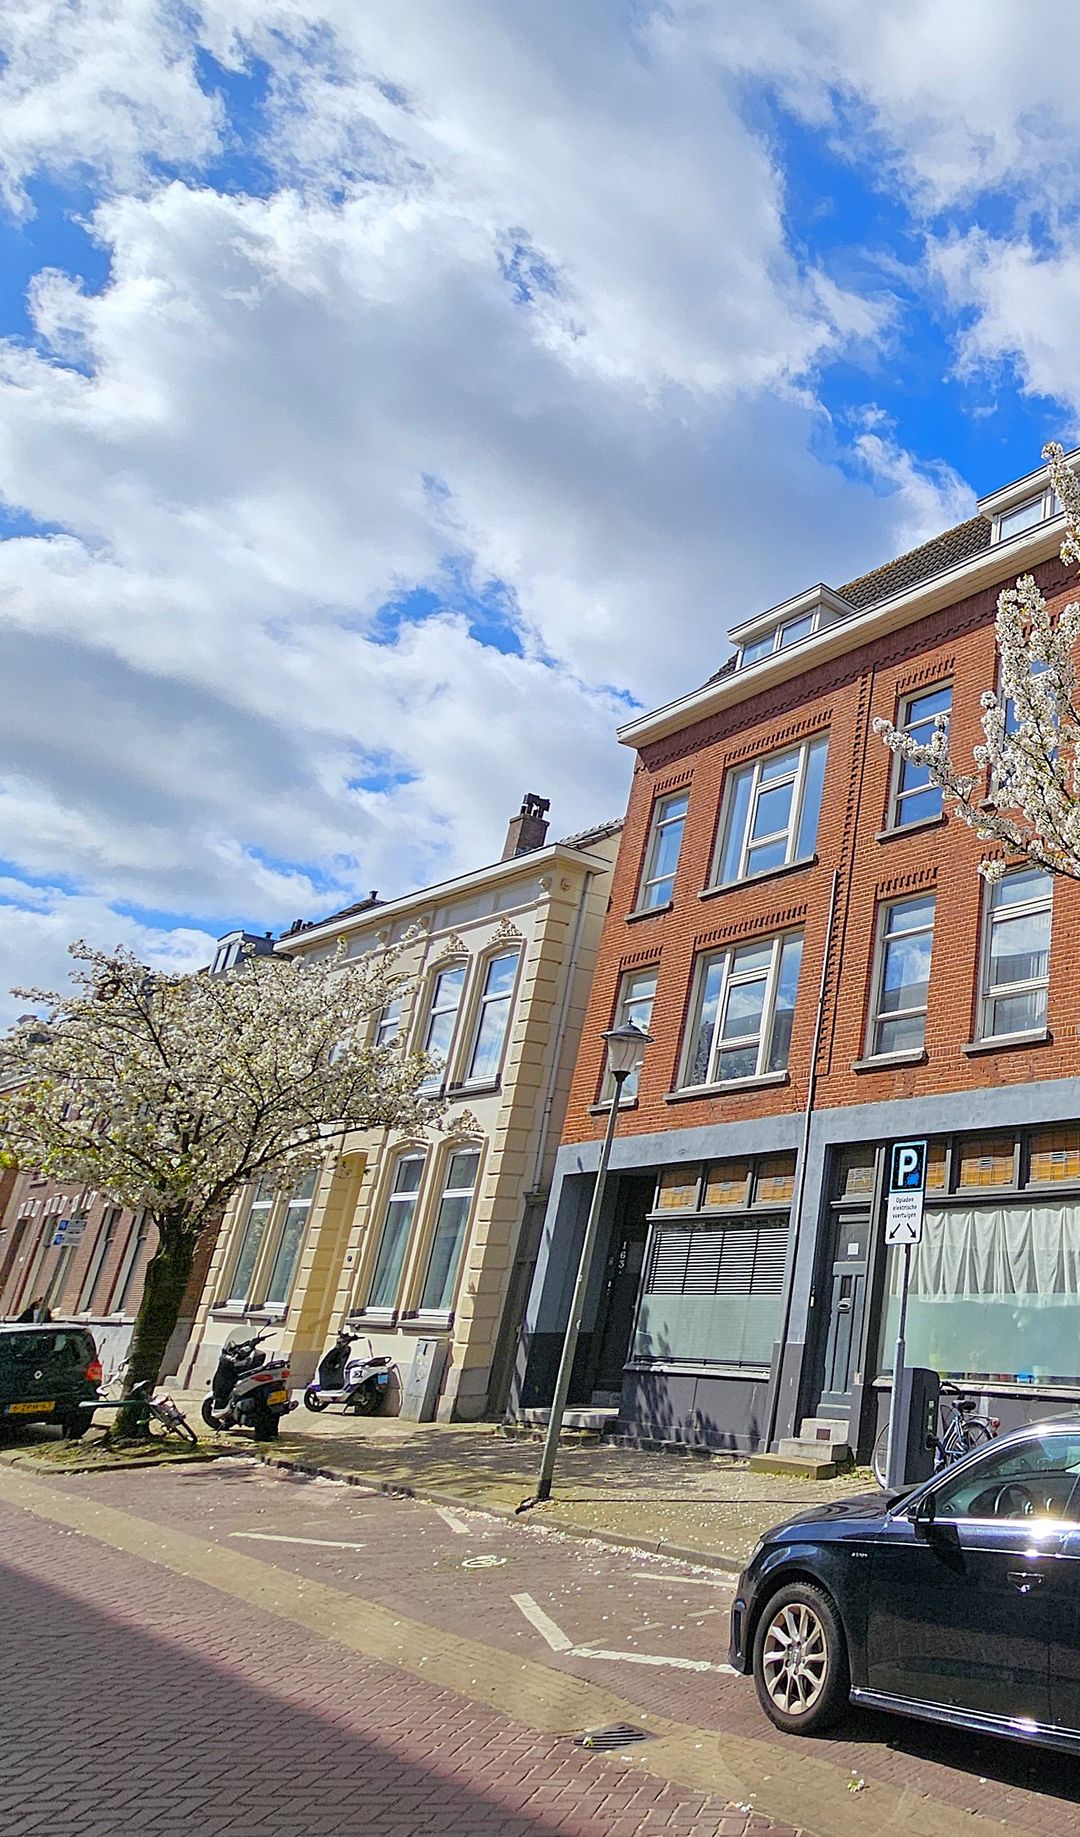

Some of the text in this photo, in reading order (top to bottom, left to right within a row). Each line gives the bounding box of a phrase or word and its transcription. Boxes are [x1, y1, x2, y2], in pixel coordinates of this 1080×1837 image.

[897, 1148, 919, 1187] P
[895, 1196, 915, 1204] Opladen
[618, 1241, 627, 1269] 163
